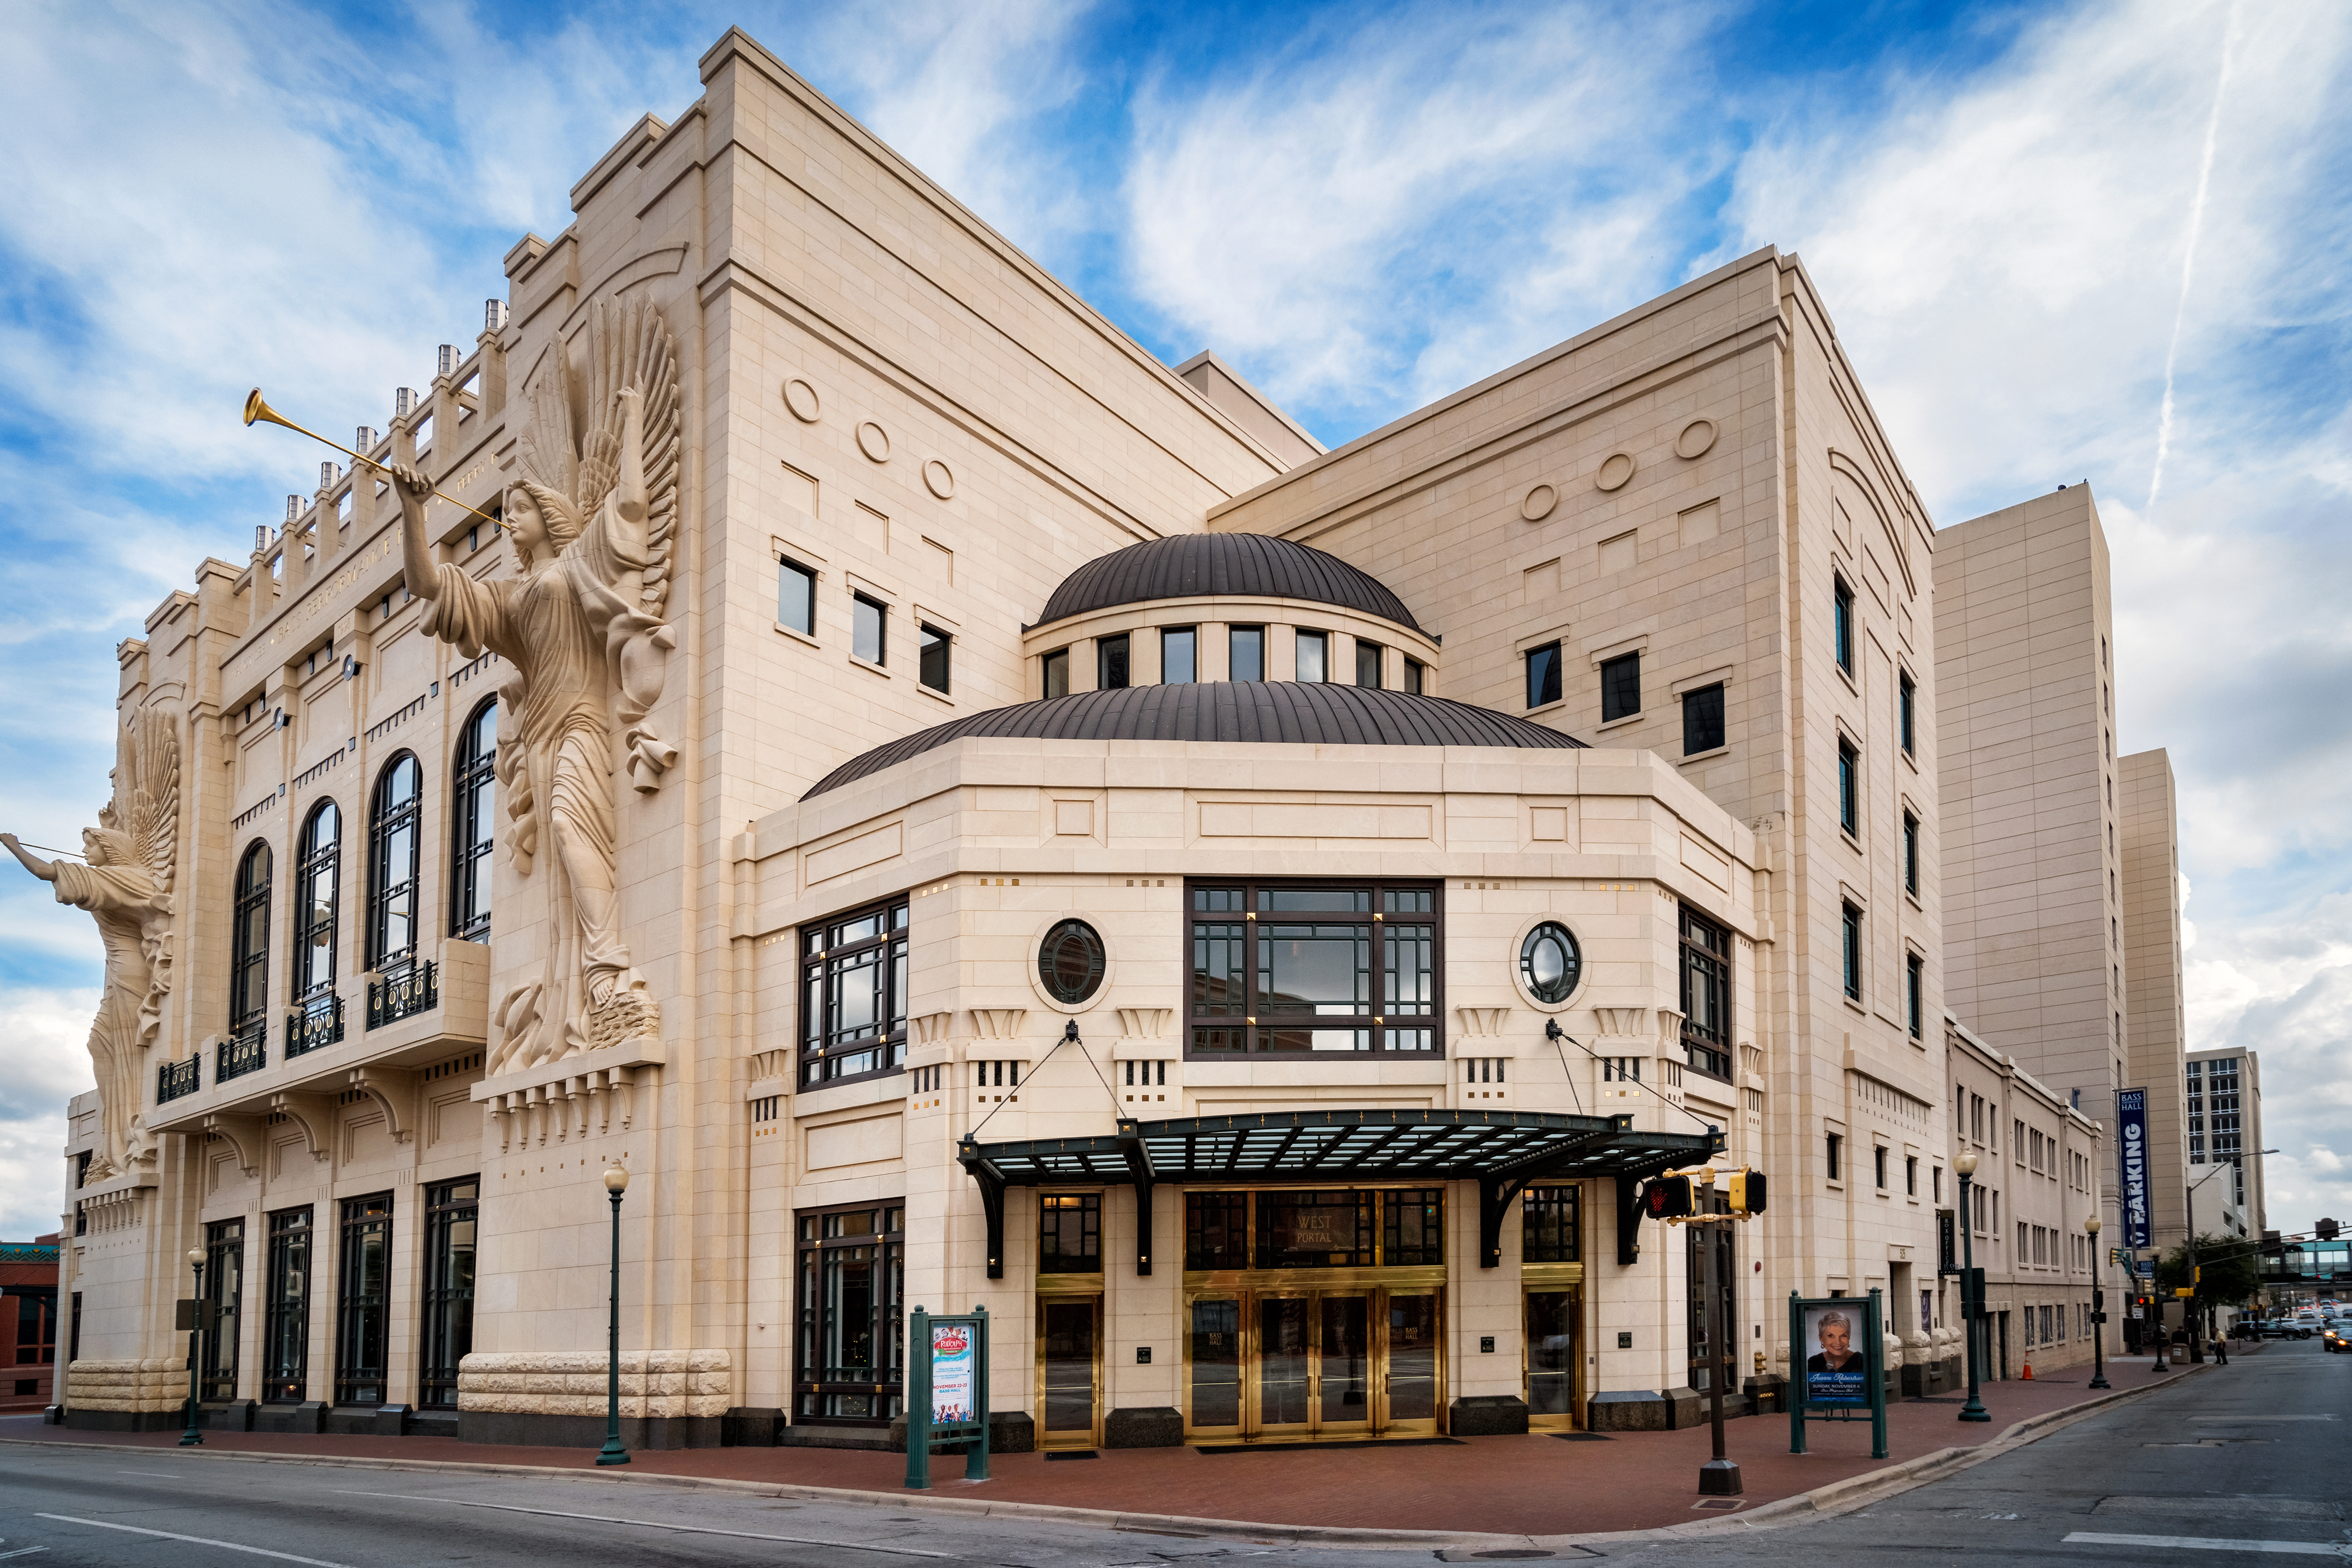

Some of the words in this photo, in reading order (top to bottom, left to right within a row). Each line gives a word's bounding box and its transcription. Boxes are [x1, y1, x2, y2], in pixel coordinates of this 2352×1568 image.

[306, 535, 391, 621] PERFORMANCE
[457, 458, 486, 493] PERRY
[2121, 1093, 2142, 1101] BASS
[2125, 1123, 2146, 1224] PARKING
[1297, 1216, 1332, 1228] WEST
[1297, 1233, 1332, 1242] PORTAL
[941, 1339, 962, 1348] RUDOLPH
[1809, 1373, 1832, 1382] Jeanne
[1833, 1373, 1864, 1384] Robertson
